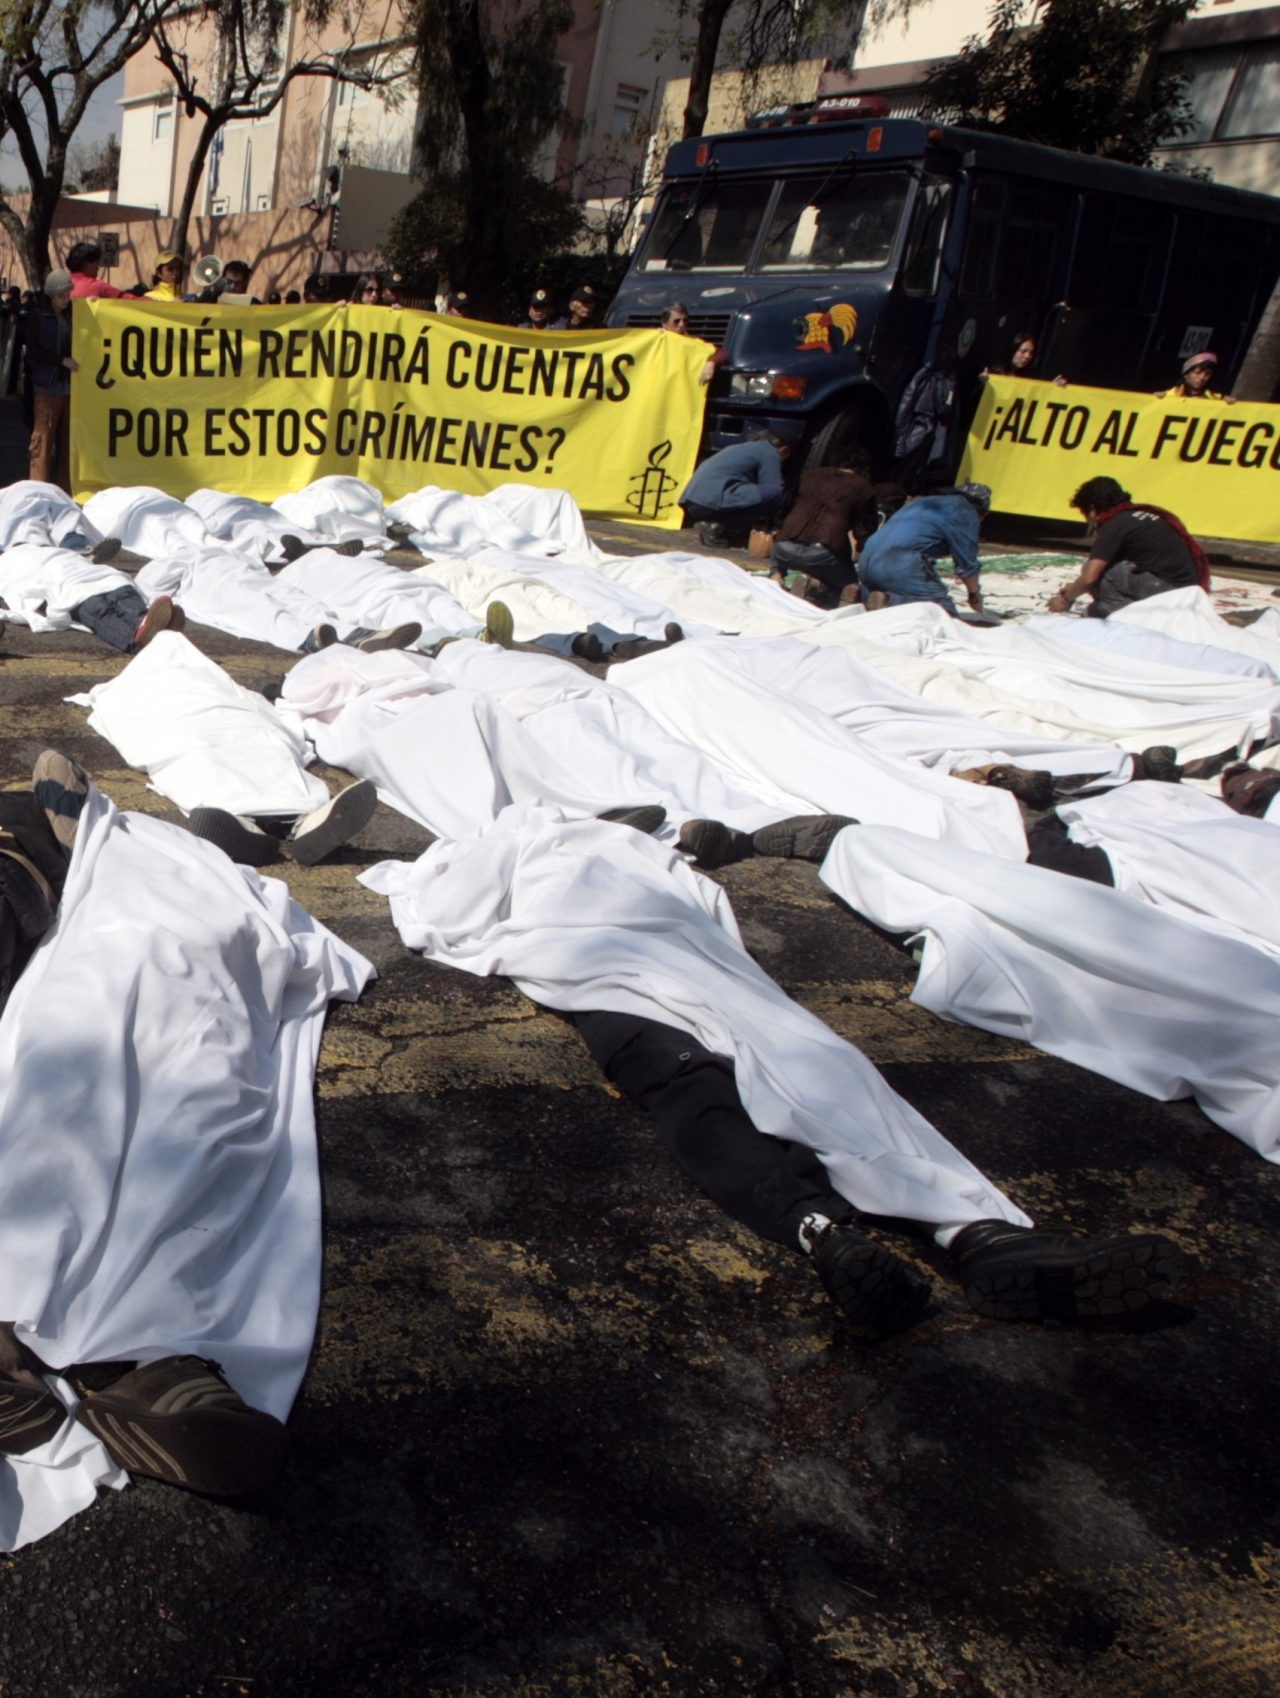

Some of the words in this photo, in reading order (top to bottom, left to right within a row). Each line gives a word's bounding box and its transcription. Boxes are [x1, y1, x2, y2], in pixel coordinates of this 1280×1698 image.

[95, 317, 244, 390] ¿QUIÉN
[256, 326, 433, 386] RENDIRÁ
[445, 340, 636, 403] CUENTAS
[108, 408, 189, 458] POR
[204, 408, 329, 457] ESTOS
[334, 402, 567, 475] CRÍMENES?
[982, 397, 1091, 451] ¡ALTO
[1090, 409, 1140, 457] AL
